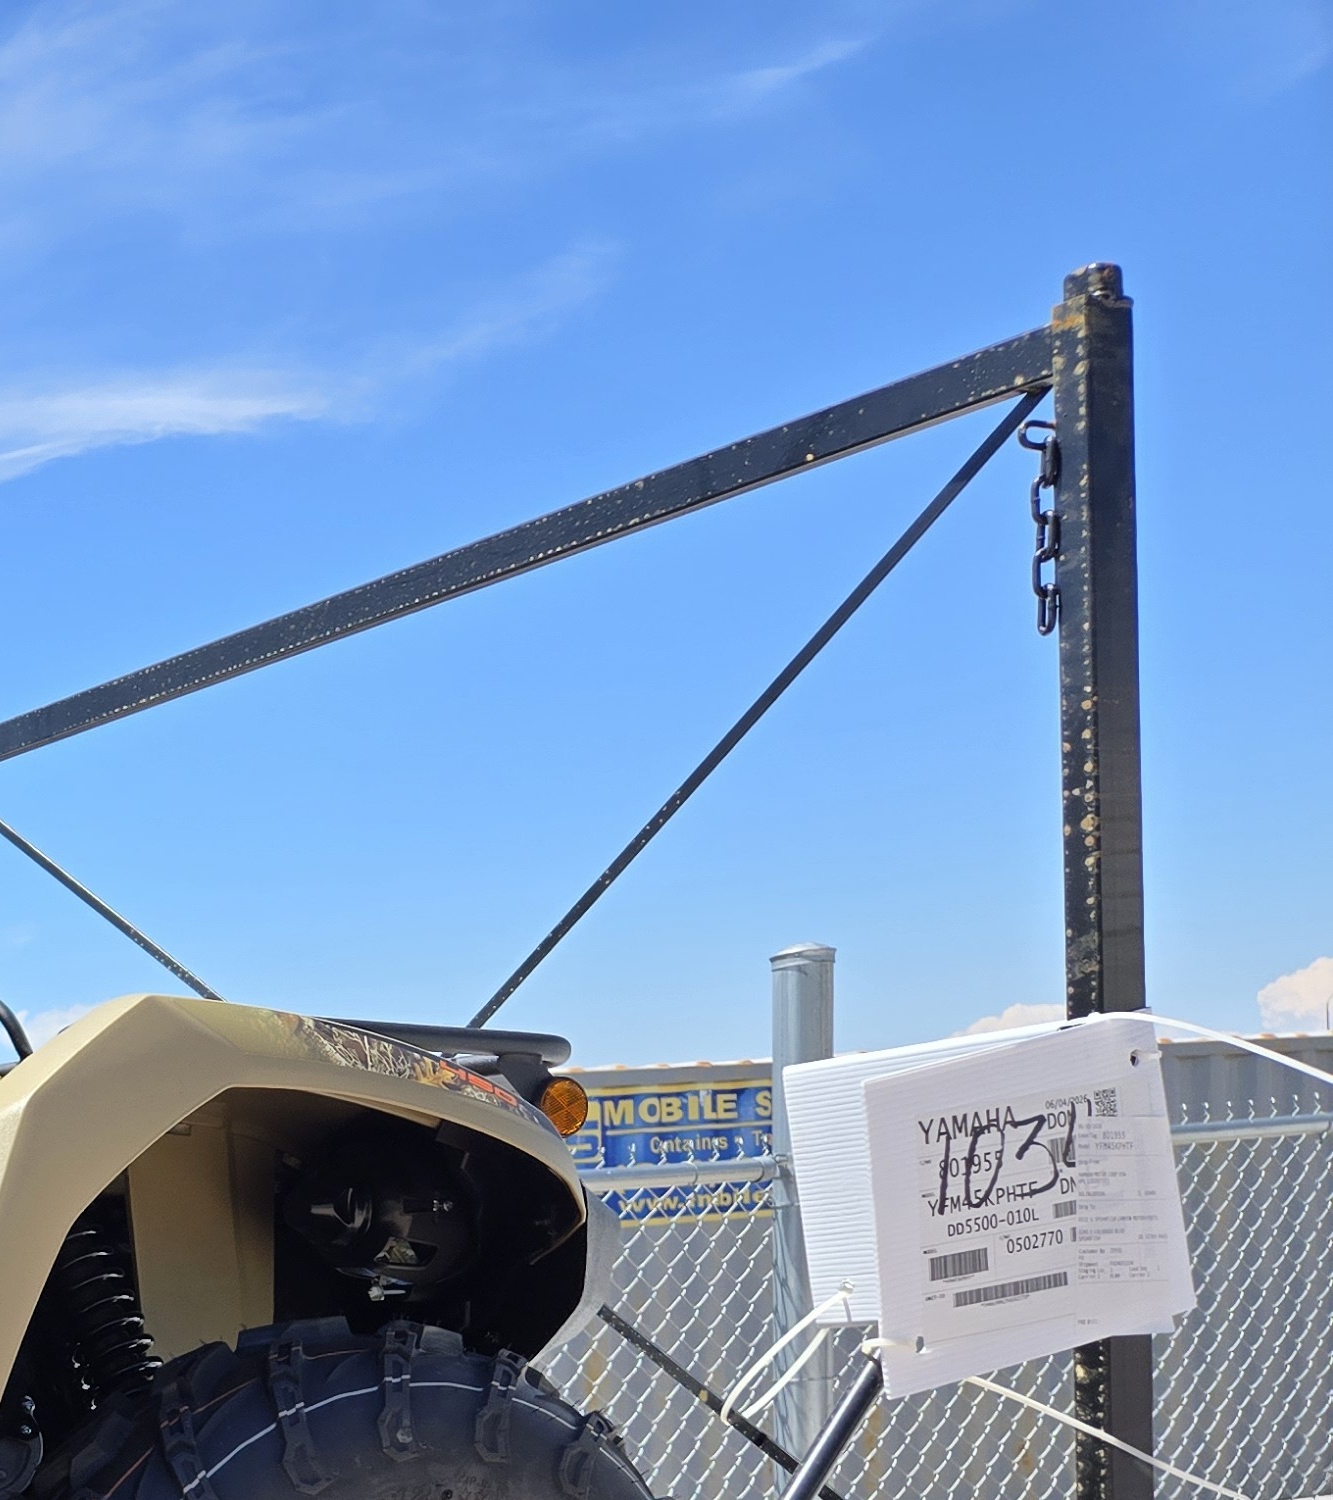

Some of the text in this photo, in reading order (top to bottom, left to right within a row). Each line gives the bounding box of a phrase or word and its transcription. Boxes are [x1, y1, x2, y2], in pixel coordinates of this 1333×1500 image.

[439, 1059, 518, 1108] 450
[603, 1091, 738, 1127] MOBILE
[917, 1105, 1018, 1145] YAMAHA
[947, 1207, 1040, 1237] DD5500-010L
[1006, 1228, 1064, 1254] 0502770
